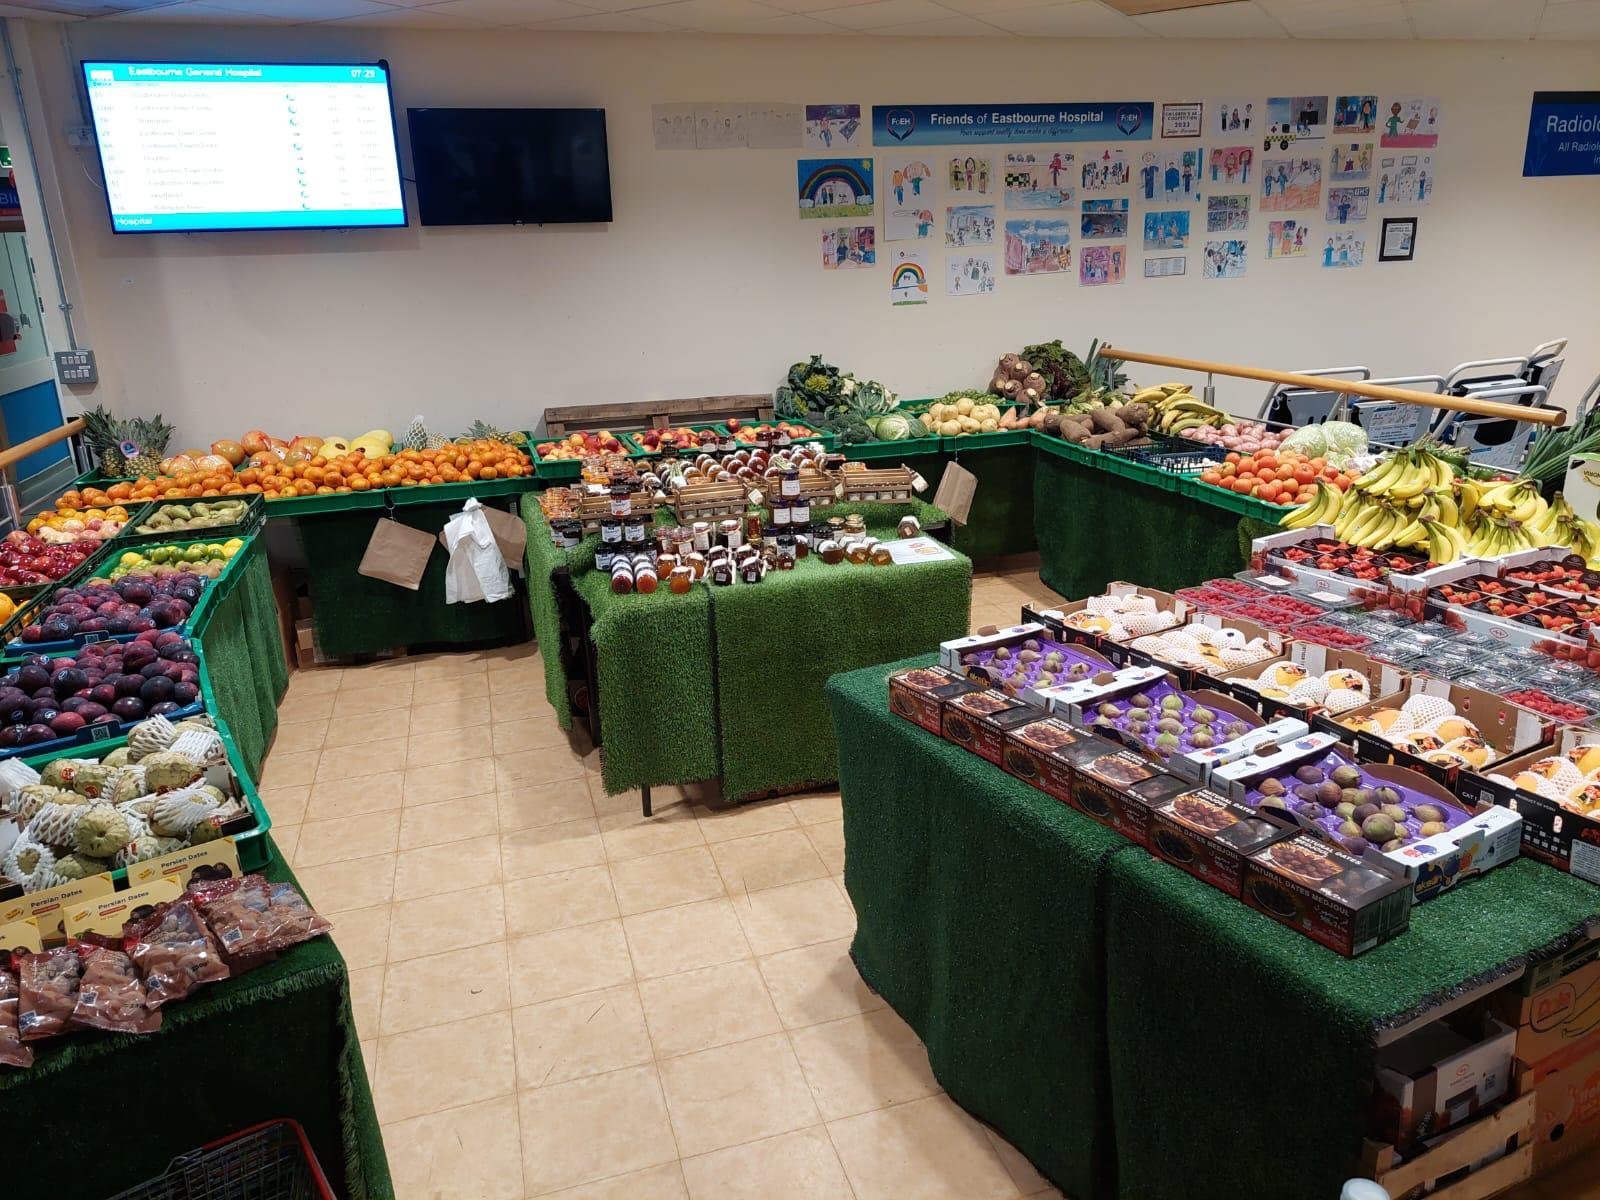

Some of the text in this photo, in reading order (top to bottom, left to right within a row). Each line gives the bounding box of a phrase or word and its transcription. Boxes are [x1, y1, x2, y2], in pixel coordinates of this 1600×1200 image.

[930, 111, 1104, 125] Friends of Eastbourne Hospital
[1558, 142, 1570, 152] All
[1006, 738, 1028, 752] NATURAL
[1074, 771, 1147, 813] NATURAL DATES MEDJOUL
[1462, 791, 1475, 800] CAT
[1201, 789, 1257, 815] NATURAL DATES
[1153, 813, 1183, 833] NATURAL
[1184, 830, 1206, 844] DATES
[1206, 840, 1239, 860] MEDJOUL
[161, 850, 208, 868] Persian Dates
[1300, 835, 1362, 865] NATURAL DATES
[30, 888, 83, 908] Persian Dates
[1249, 863, 1282, 884] NATURAL
[1285, 881, 1310, 897] DATES
[1311, 893, 1350, 917] MEDJOUL
[98, 891, 149, 910] Persian Dates
